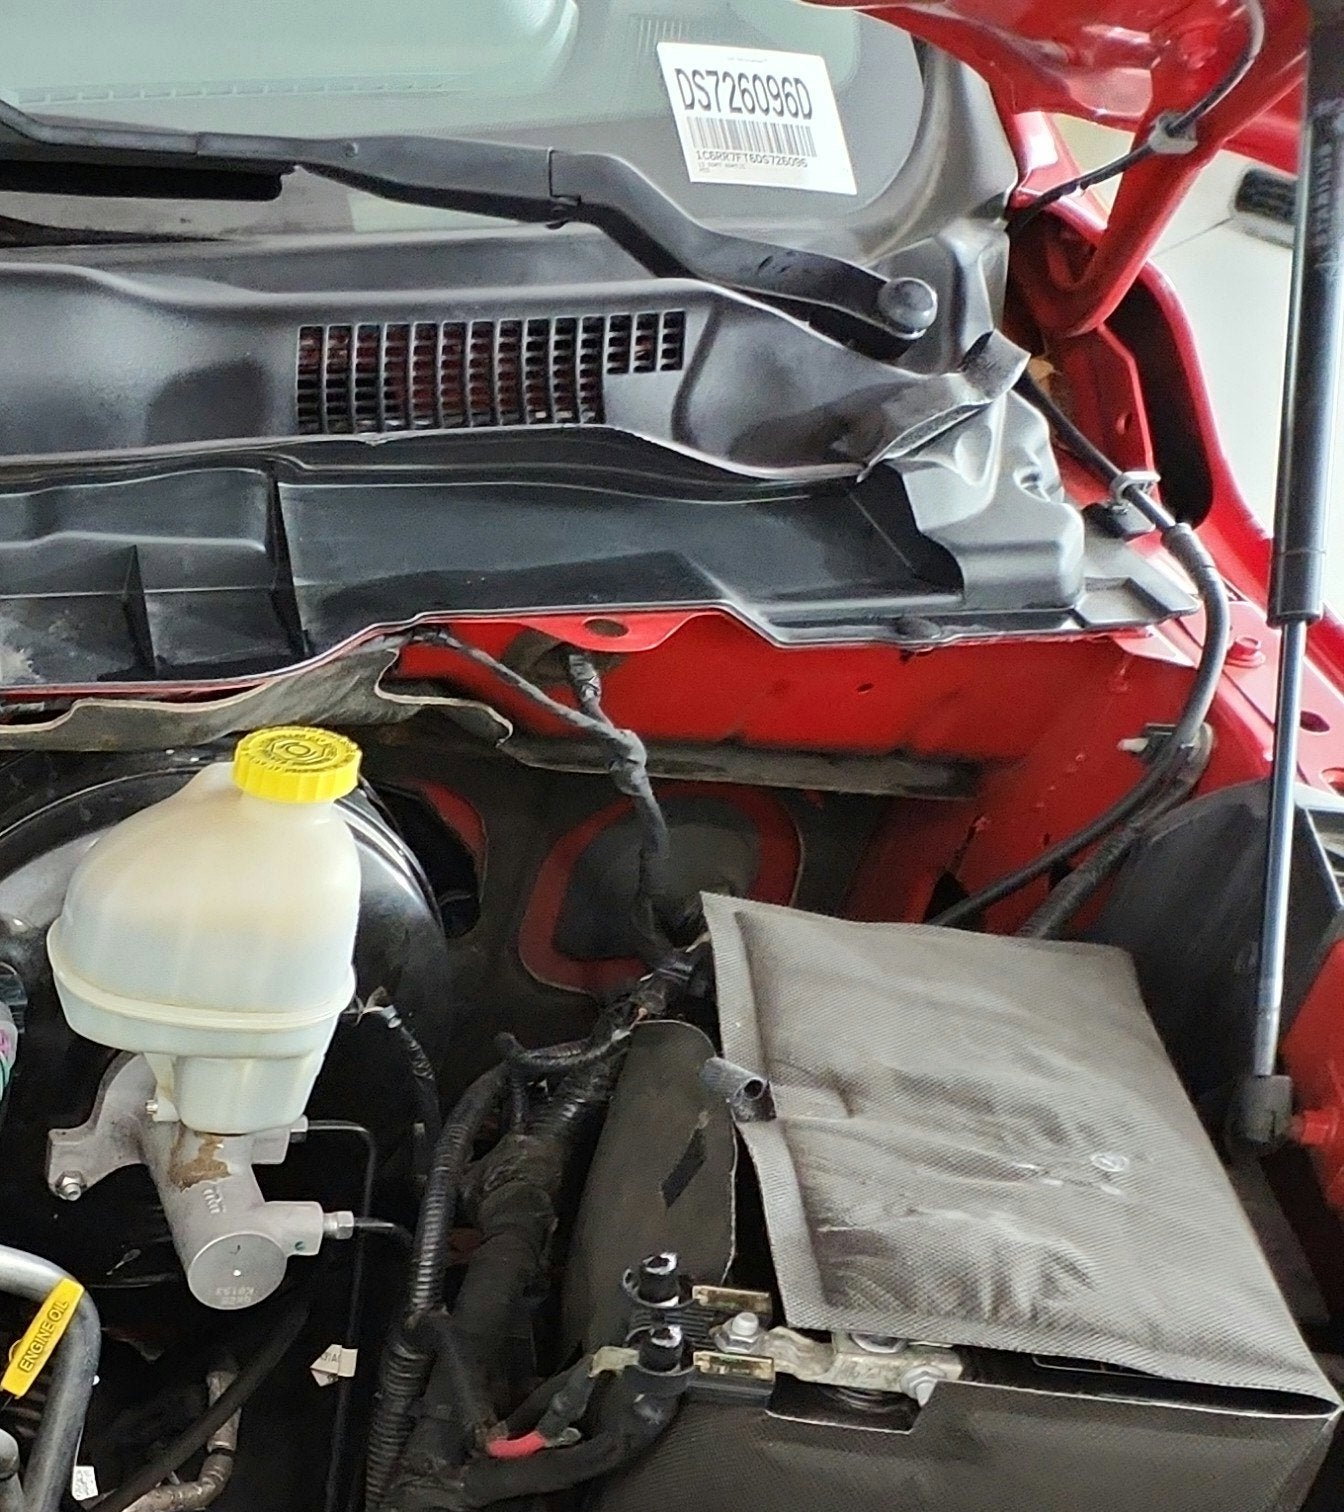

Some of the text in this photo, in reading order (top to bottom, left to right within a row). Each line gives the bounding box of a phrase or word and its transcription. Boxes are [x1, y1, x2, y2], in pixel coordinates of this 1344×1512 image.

[674, 67, 813, 120] DS726096D
[17, 1300, 70, 1373] ENGINE OIL
